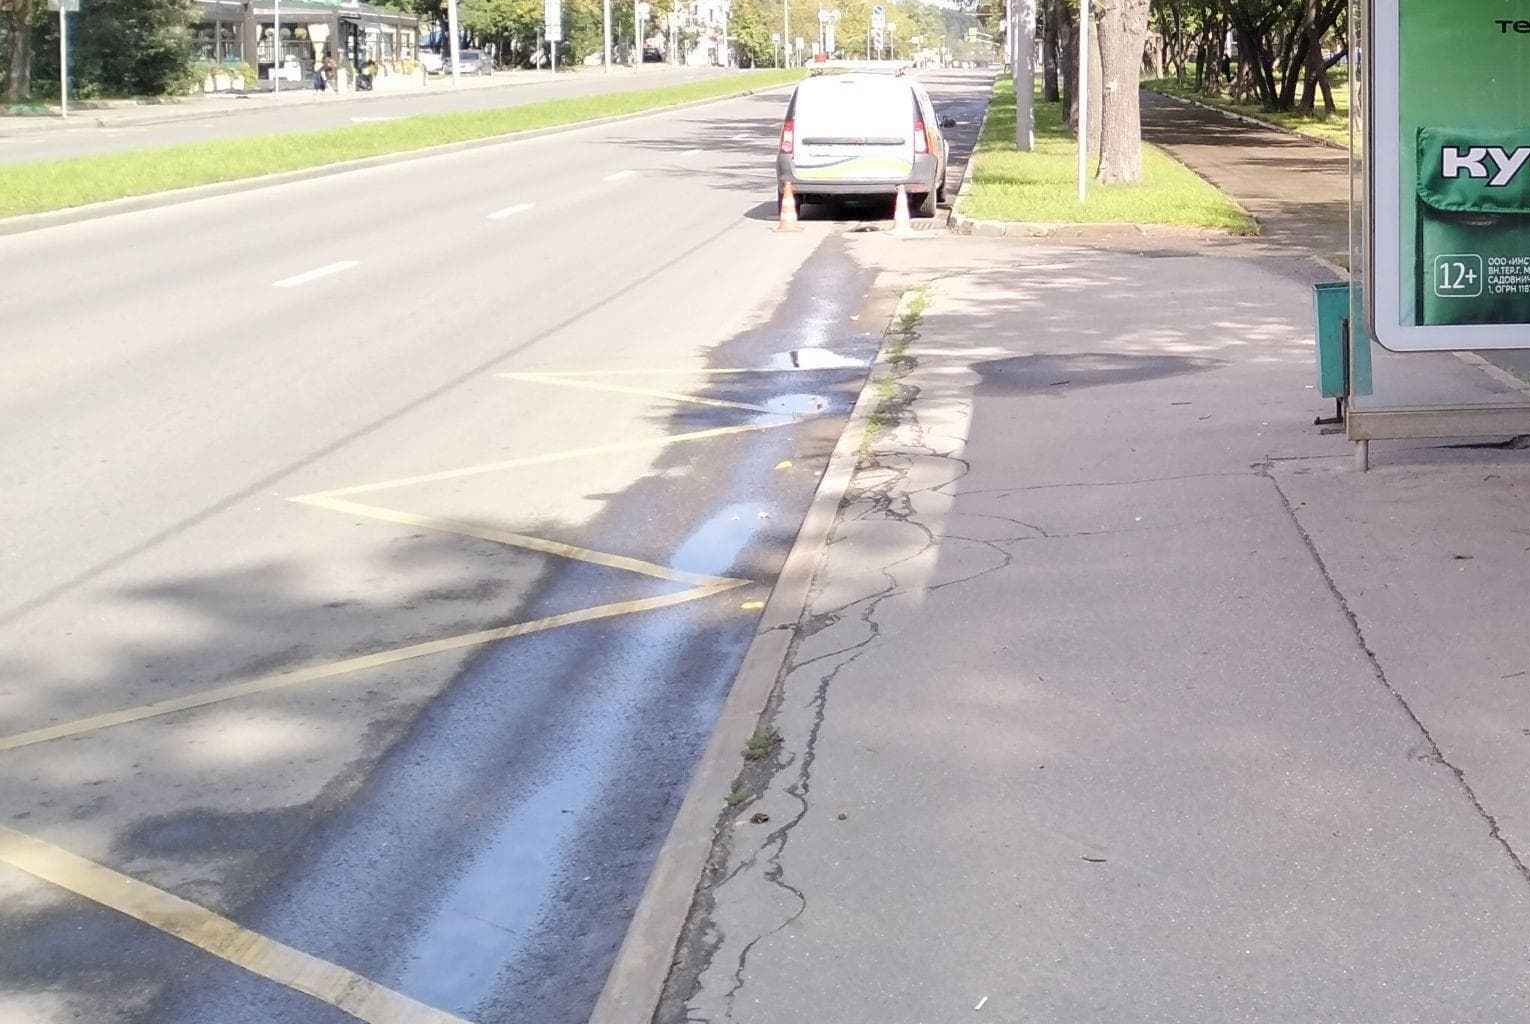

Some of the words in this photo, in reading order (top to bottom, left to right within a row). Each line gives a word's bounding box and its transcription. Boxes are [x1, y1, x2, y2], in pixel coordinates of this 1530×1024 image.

[1488, 257, 1507, 265] ООО
[1439, 262, 1478, 289] 12+
[1495, 285, 1517, 293] ОГРН
